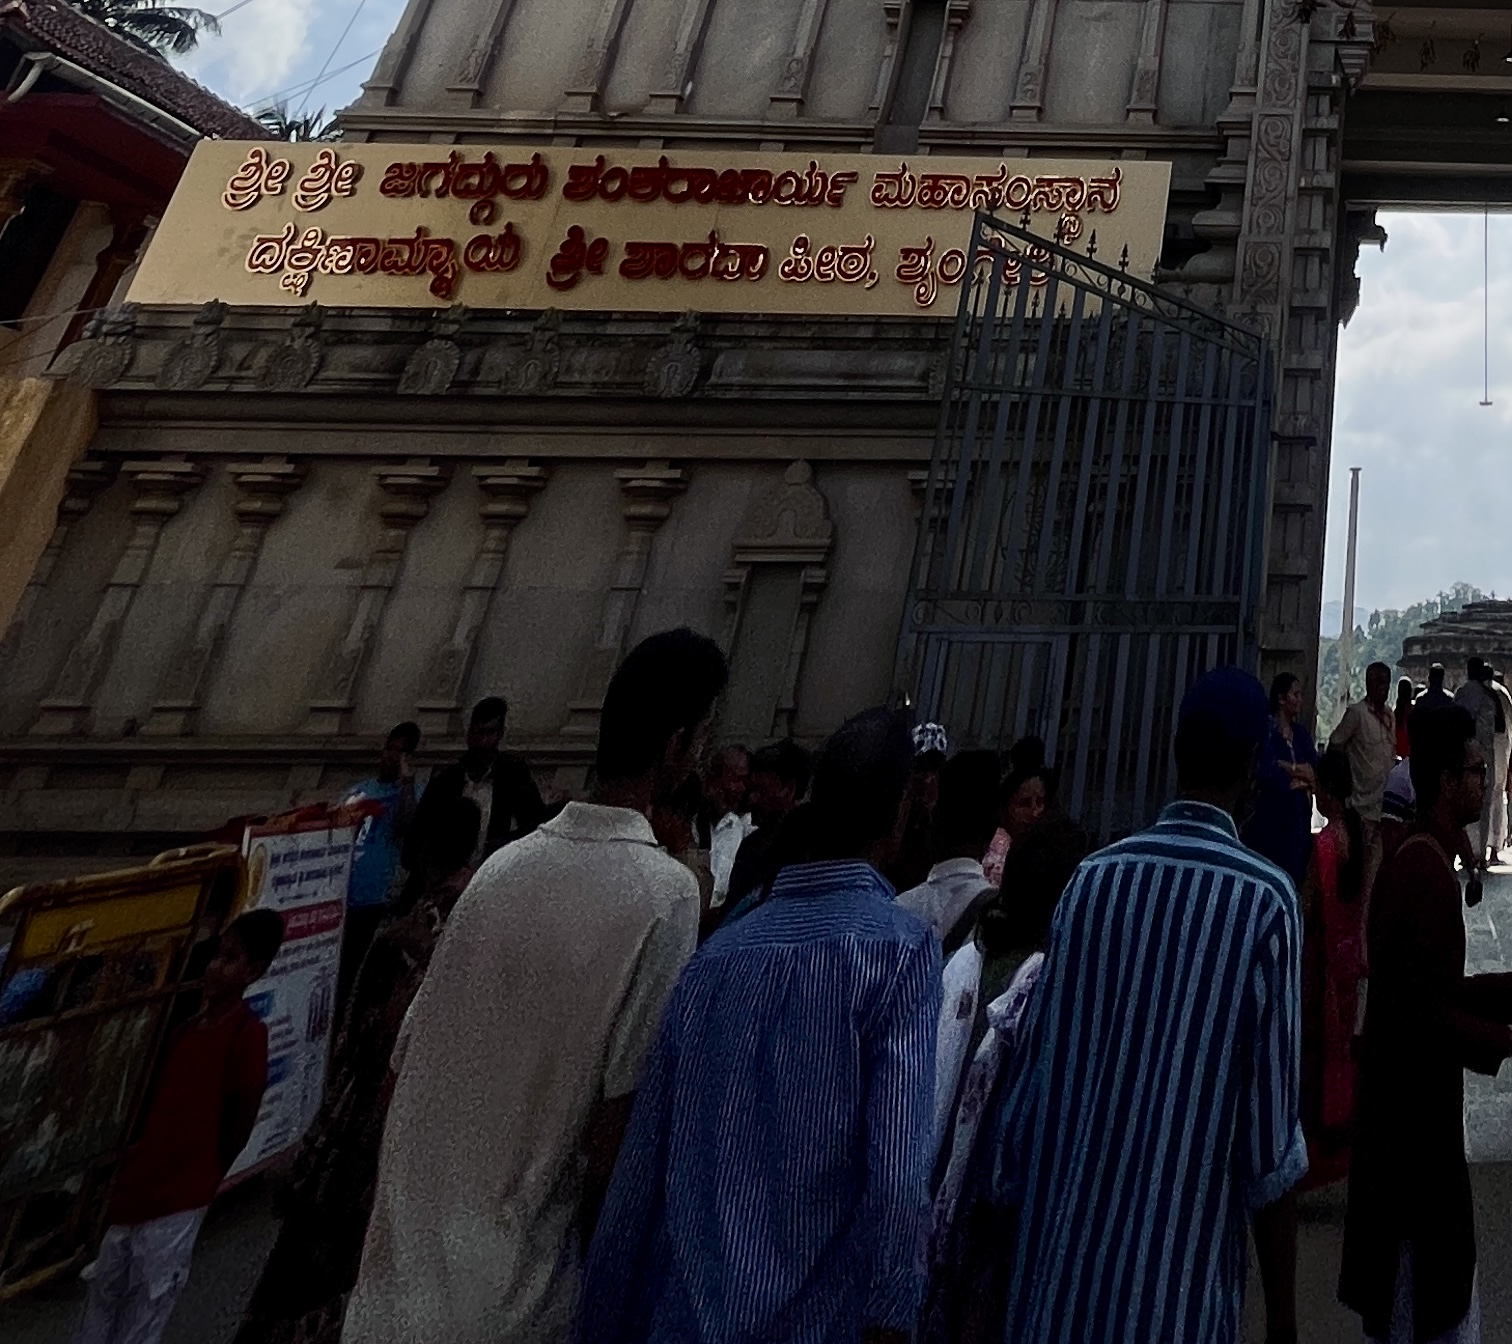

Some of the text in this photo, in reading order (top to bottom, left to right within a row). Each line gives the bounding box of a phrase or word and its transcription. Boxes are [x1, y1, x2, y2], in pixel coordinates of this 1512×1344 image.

[221, 146, 292, 211] ಶ್ರೀ
[292, 147, 363, 212] ಶ್ರೀ
[380, 150, 549, 226] ಜಗದ್ಗುರು
[546, 225, 609, 291] ಶ್ರೀ
